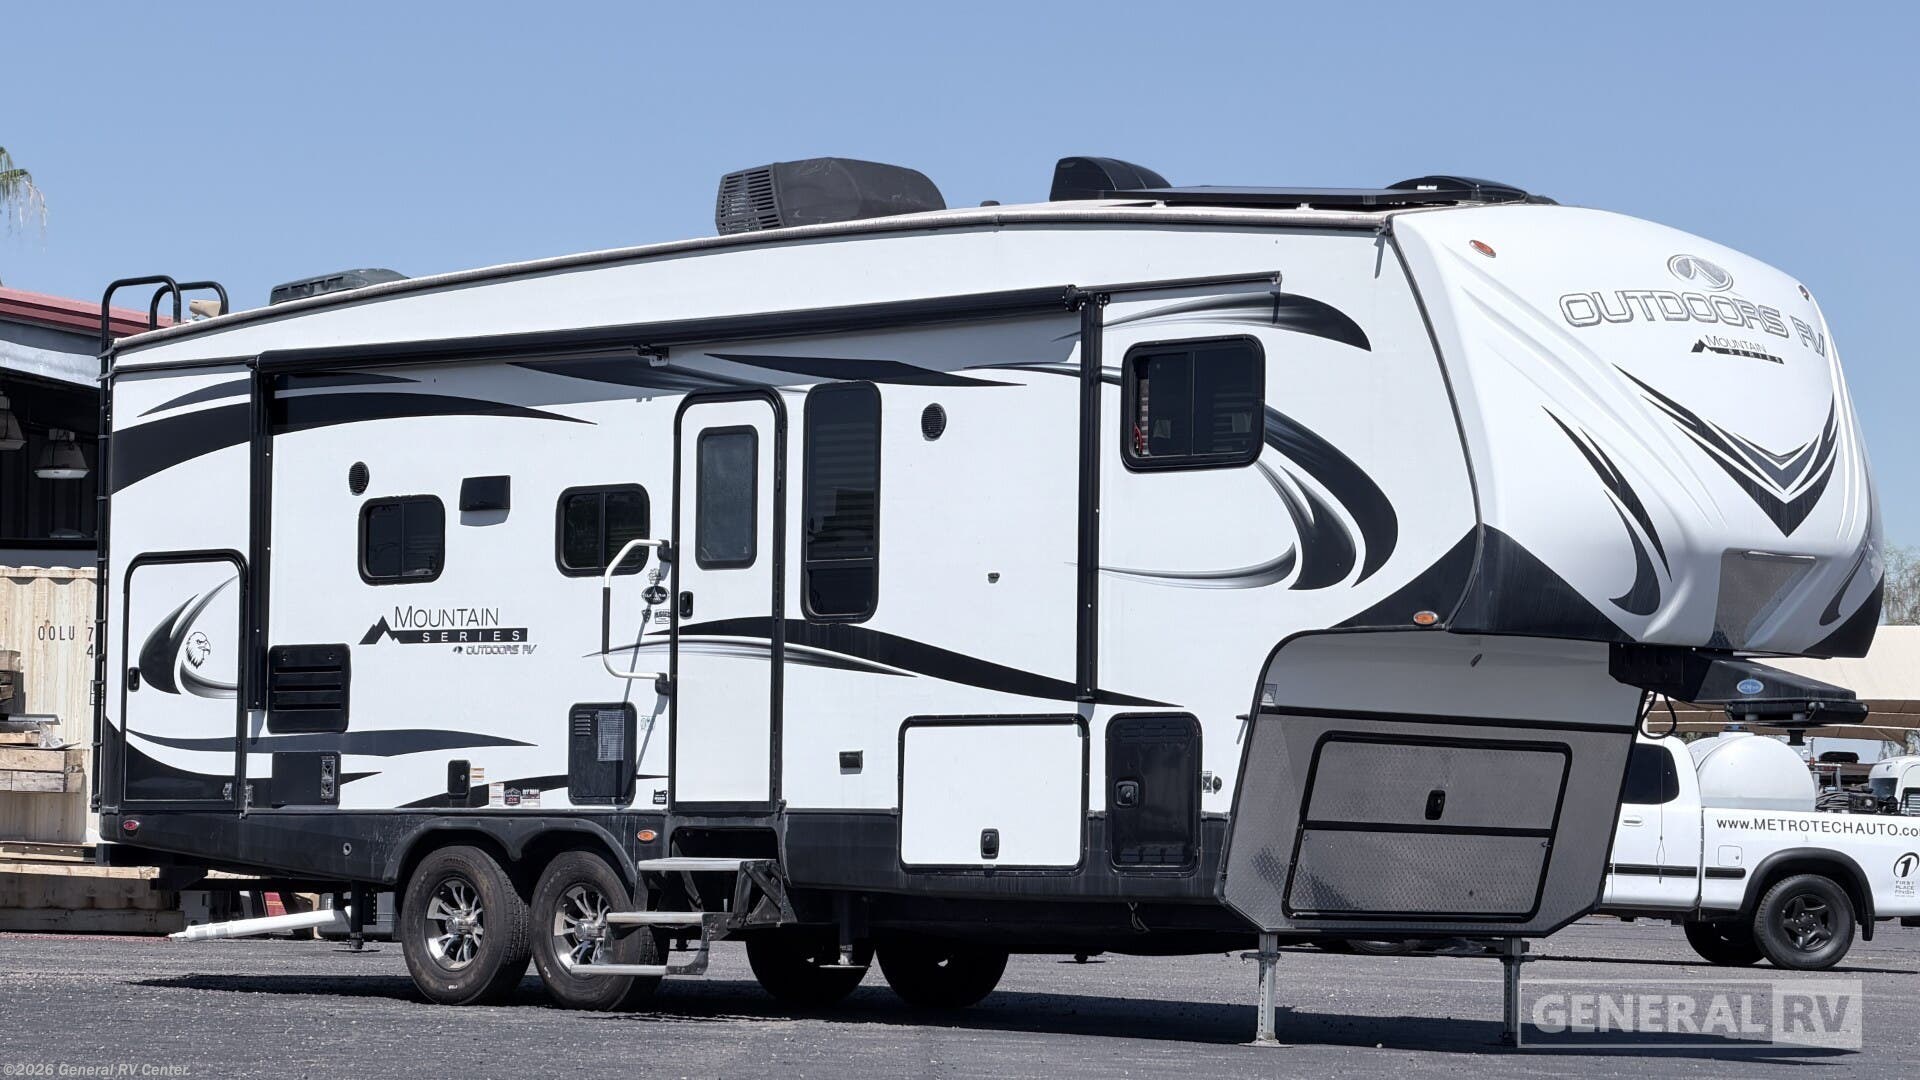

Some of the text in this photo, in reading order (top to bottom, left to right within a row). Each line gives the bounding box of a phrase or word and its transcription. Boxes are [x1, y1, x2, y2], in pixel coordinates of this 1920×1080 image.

[1559, 290, 1825, 357] OUTDOORS RV
[394, 605, 499, 628] MOUNTAIN
[422, 630, 520, 643] SERIES
[466, 644, 538, 655] OUTDOORS RV
[1716, 818, 1920, 837] www.METROTECHAUTO.co
